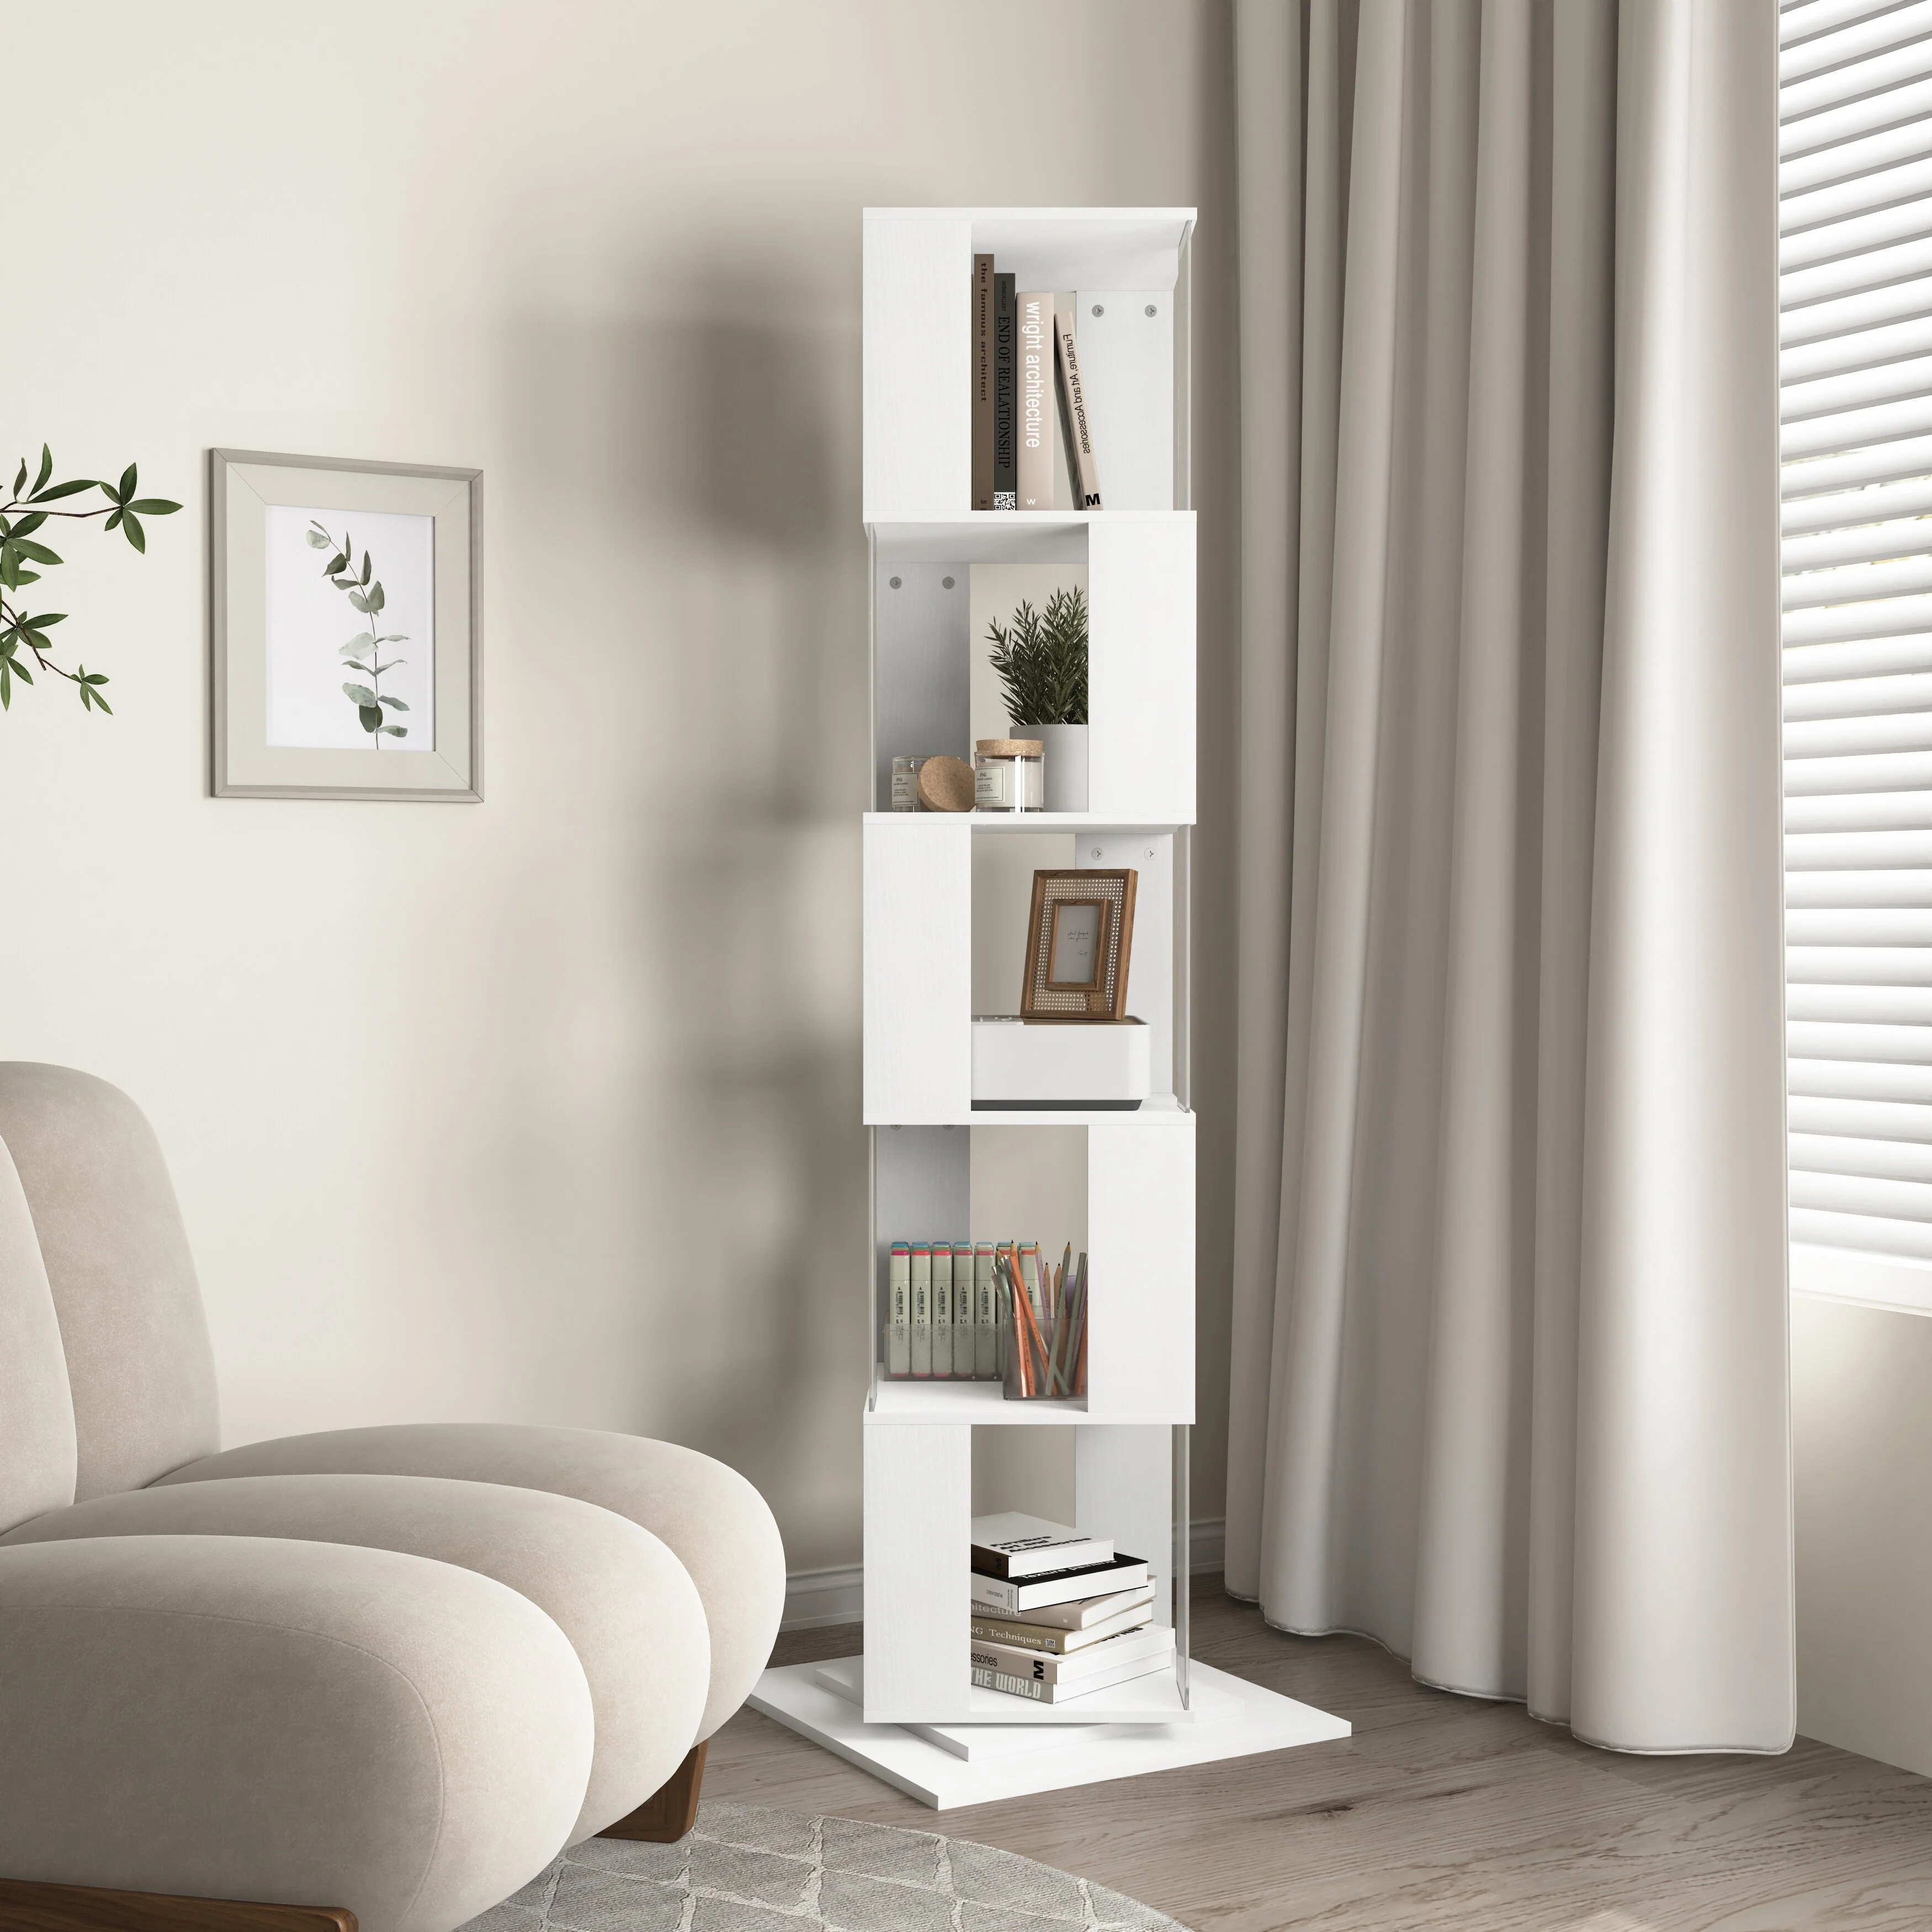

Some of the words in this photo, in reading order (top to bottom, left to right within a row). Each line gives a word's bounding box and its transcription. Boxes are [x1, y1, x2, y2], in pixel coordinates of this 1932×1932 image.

[999, 316, 1010, 343] END
[1022, 301, 1044, 349] wright
[999, 347, 1010, 363] OF
[1026, 355, 1044, 448] architecture
[999, 367, 1010, 468] REALATIONSHIP
[1085, 493, 1101, 506] M
[990, 1536, 1052, 1547] Furniture
[1009, 1537, 1092, 1553] Accessories
[989, 1628, 1042, 1645] Techniques
[971, 1652, 997, 1666] ssories
[1033, 1660, 1044, 1680] M
[996, 1673, 1041, 1699] WORLD
